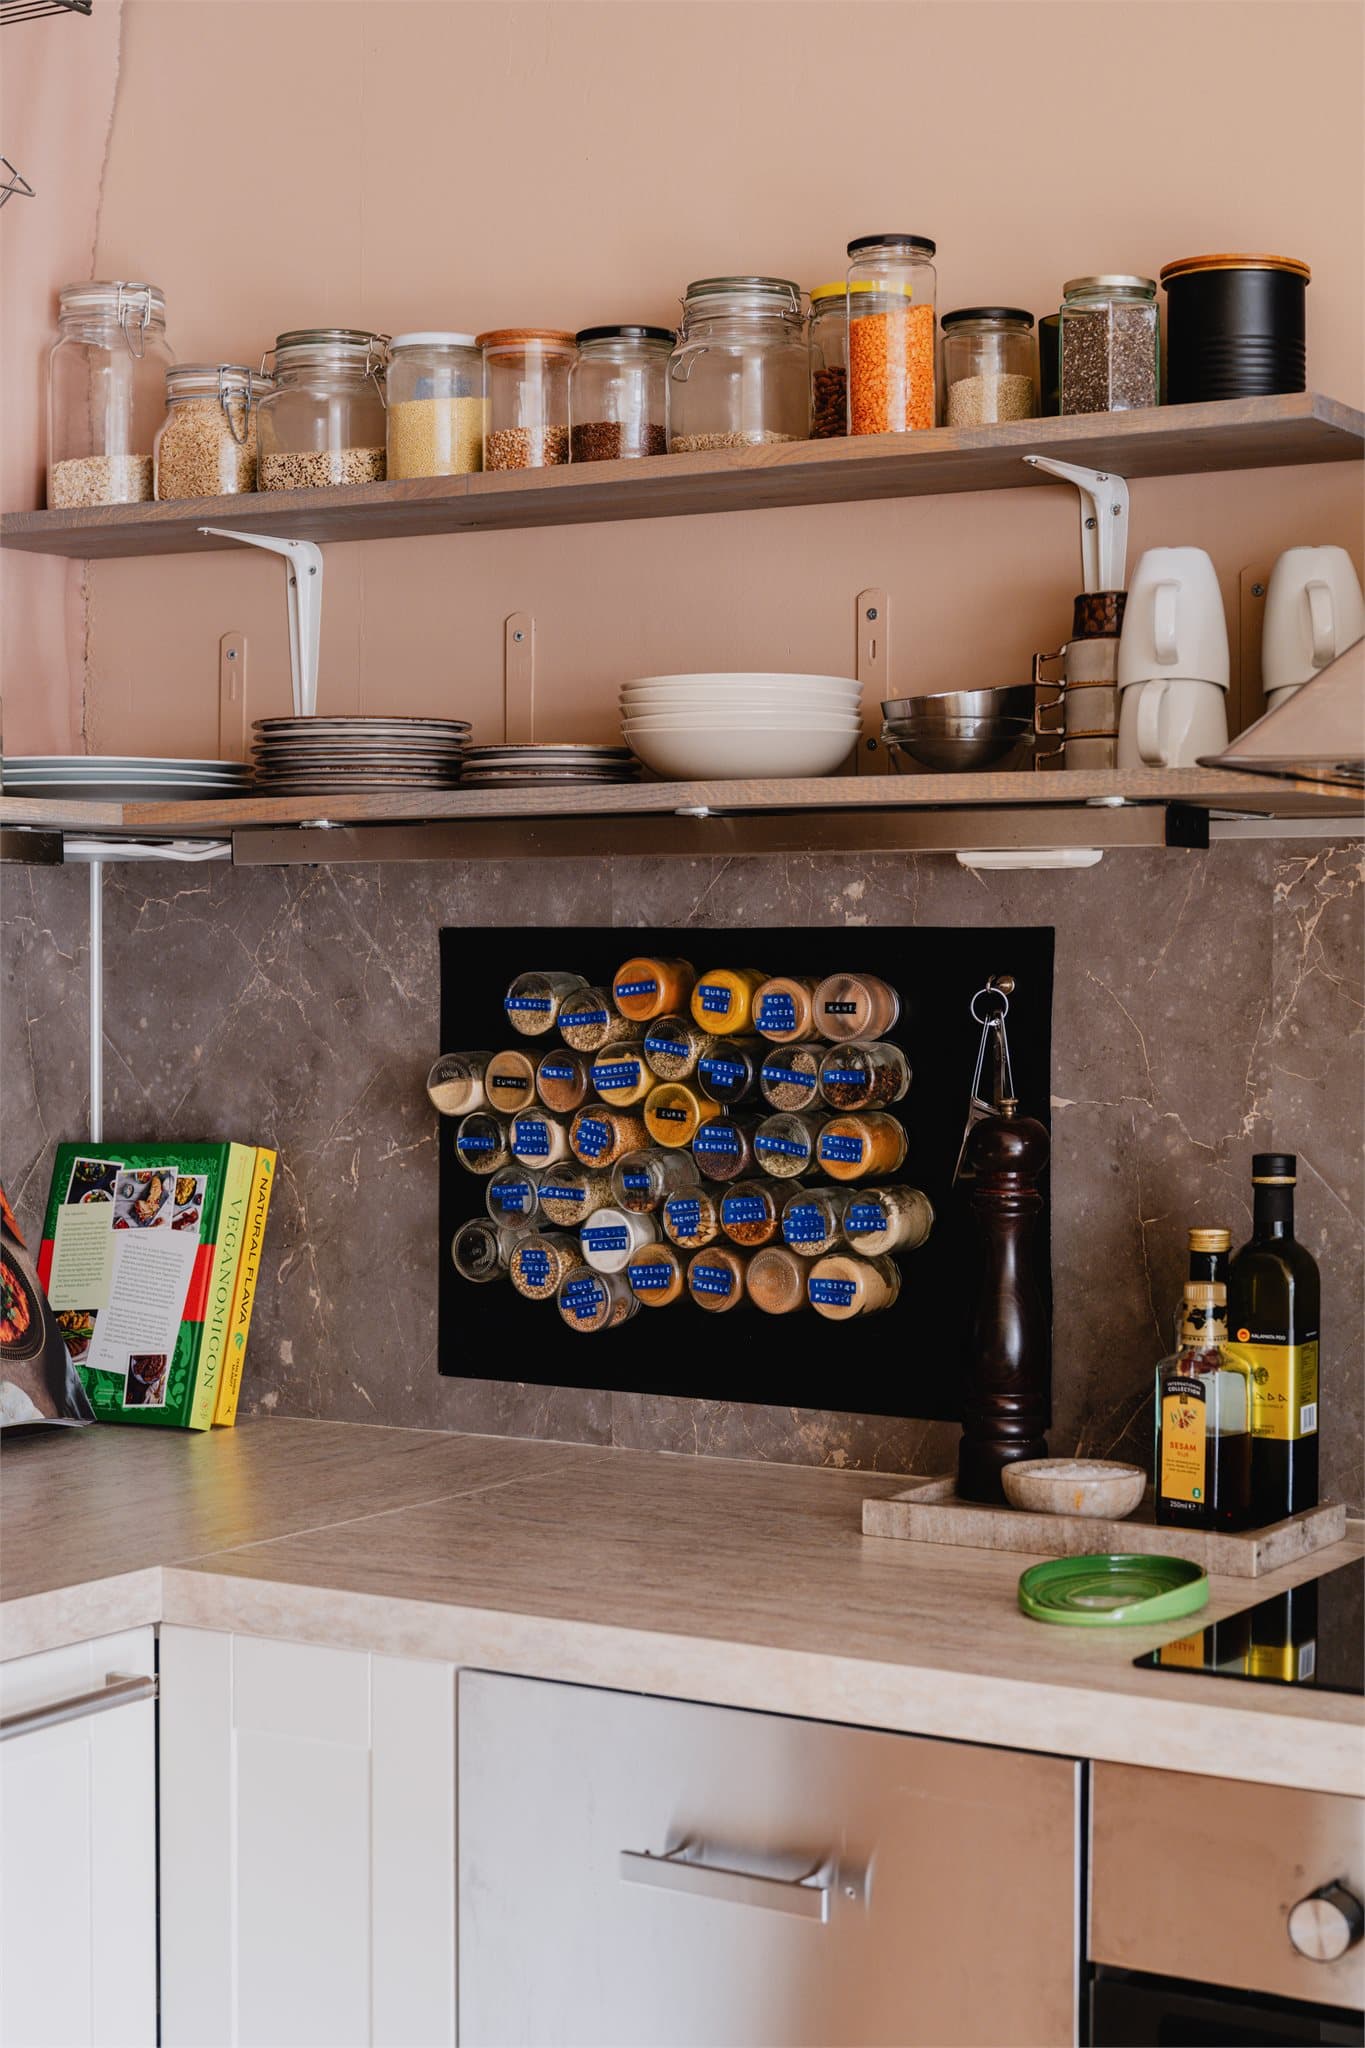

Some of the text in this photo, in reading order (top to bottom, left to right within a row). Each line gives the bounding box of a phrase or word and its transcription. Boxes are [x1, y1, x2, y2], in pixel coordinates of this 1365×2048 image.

[618, 984, 657, 994] PAPRIKA
[704, 989, 731, 999] GURKE
[649, 1040, 689, 1056] OREGANO
[594, 1065, 640, 1076] TANDOORI
[761, 1069, 816, 1085] BASILIKUM
[598, 1078, 633, 1087] MASALA
[519, 1124, 546, 1132] KARDE
[704, 1129, 733, 1138] BRUNE
[698, 1143, 737, 1152] SENNEPS
[760, 1138, 806, 1155] PERSILLE
[826, 1150, 861, 1159] PULVER
[671, 1202, 699, 1211] KARDE
[592, 1240, 625, 1249] PULVER
[238, 1177, 269, 1325] NATURAL FLAVA
[632, 1266, 670, 1275] KAJENNE
[571, 1281, 593, 1291] GULE
[696, 1282, 730, 1293] MASALA
[203, 1199, 243, 1389] VEGANOMICON
[815, 1294, 850, 1304] PULVER
[566, 1293, 603, 1306] SENNEPS
[1167, 1386, 1201, 1396] COLLECTION
[1169, 1441, 1197, 1452] SESAM
